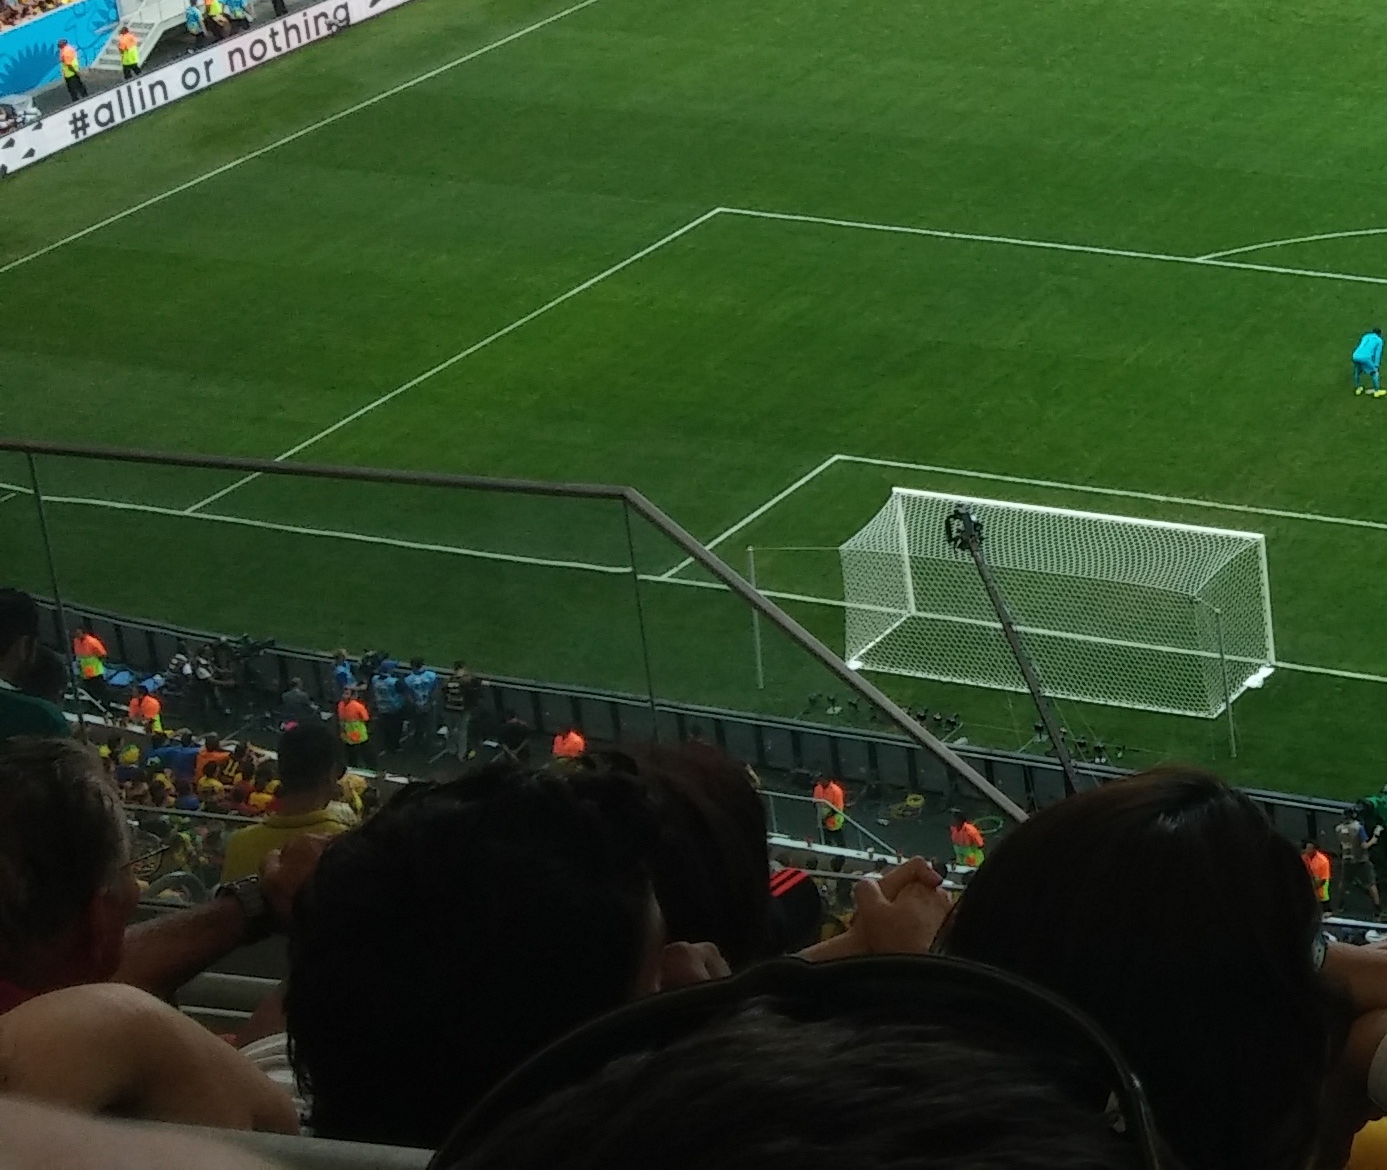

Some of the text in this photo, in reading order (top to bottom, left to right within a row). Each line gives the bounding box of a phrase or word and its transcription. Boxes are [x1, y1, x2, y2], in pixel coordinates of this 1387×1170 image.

[68, 1, 351, 139] #allin or nothing
